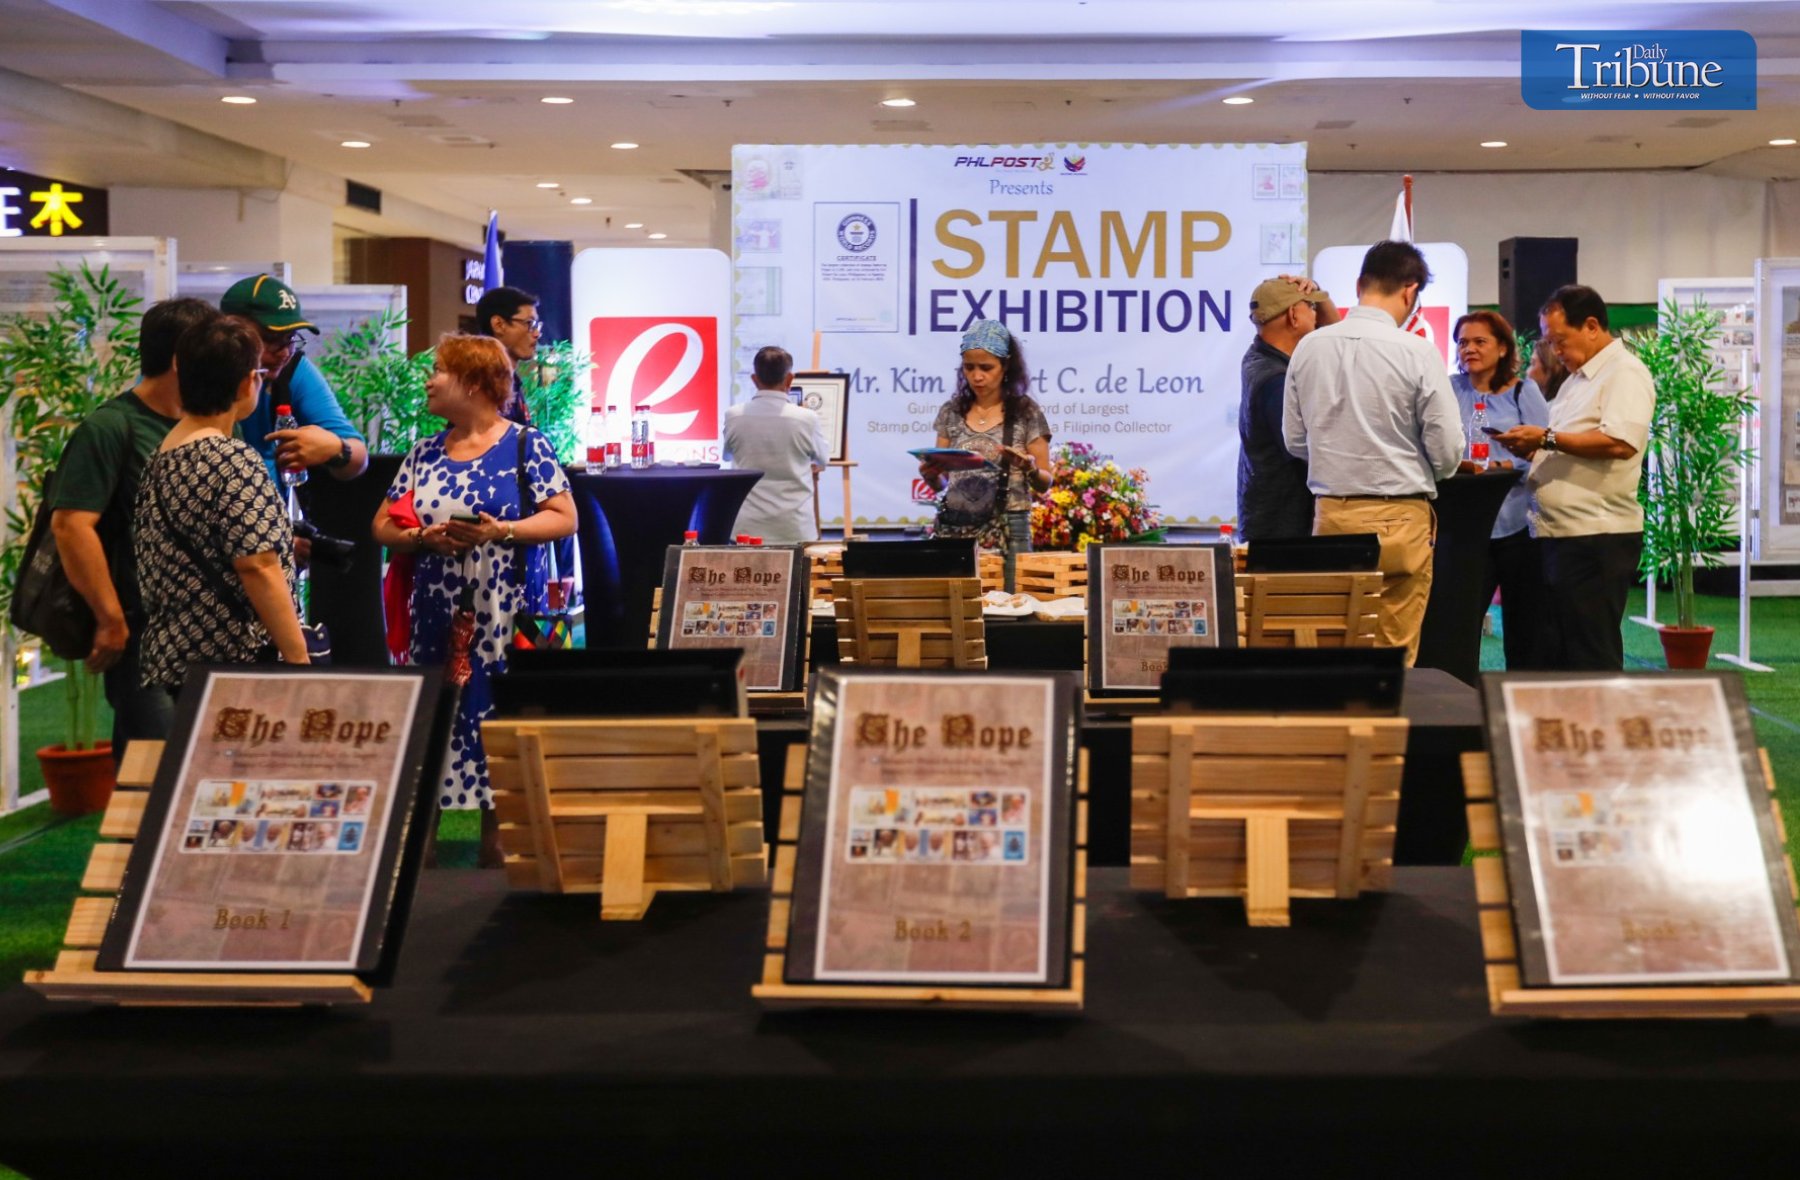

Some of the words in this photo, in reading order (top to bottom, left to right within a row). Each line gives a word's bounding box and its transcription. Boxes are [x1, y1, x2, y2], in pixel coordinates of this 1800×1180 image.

[954, 156, 1042, 168] PHLPOST
[989, 179, 1054, 195] Presents
[30, 182, 83, 236] 木
[931, 208, 1233, 280] STAMP
[929, 289, 1232, 333] EXHIBITION
[835, 367, 880, 393] Mr.
[890, 367, 946, 394] Kim
[1057, 367, 1085, 394] C.
[1095, 363, 1128, 394] de
[1136, 367, 1205, 394] Leon
[1063, 403, 1078, 415] of
[1080, 403, 1130, 417] Largest
[867, 421, 909, 434] Stamp
[1063, 421, 1111, 435] Filipino
[1114, 421, 1172, 433] Collector
[688, 567, 727, 586] The
[734, 566, 782, 586] Pope
[1111, 564, 1150, 584] The
[1157, 564, 1205, 584] Pope
[213, 707, 287, 749] The
[300, 708, 392, 748] Pope
[854, 712, 928, 752] The
[941, 713, 1034, 754] Pope
[213, 908, 271, 930] Book
[279, 908, 291, 929] 1
[894, 919, 949, 941] Book
[958, 919, 972, 941] 2
